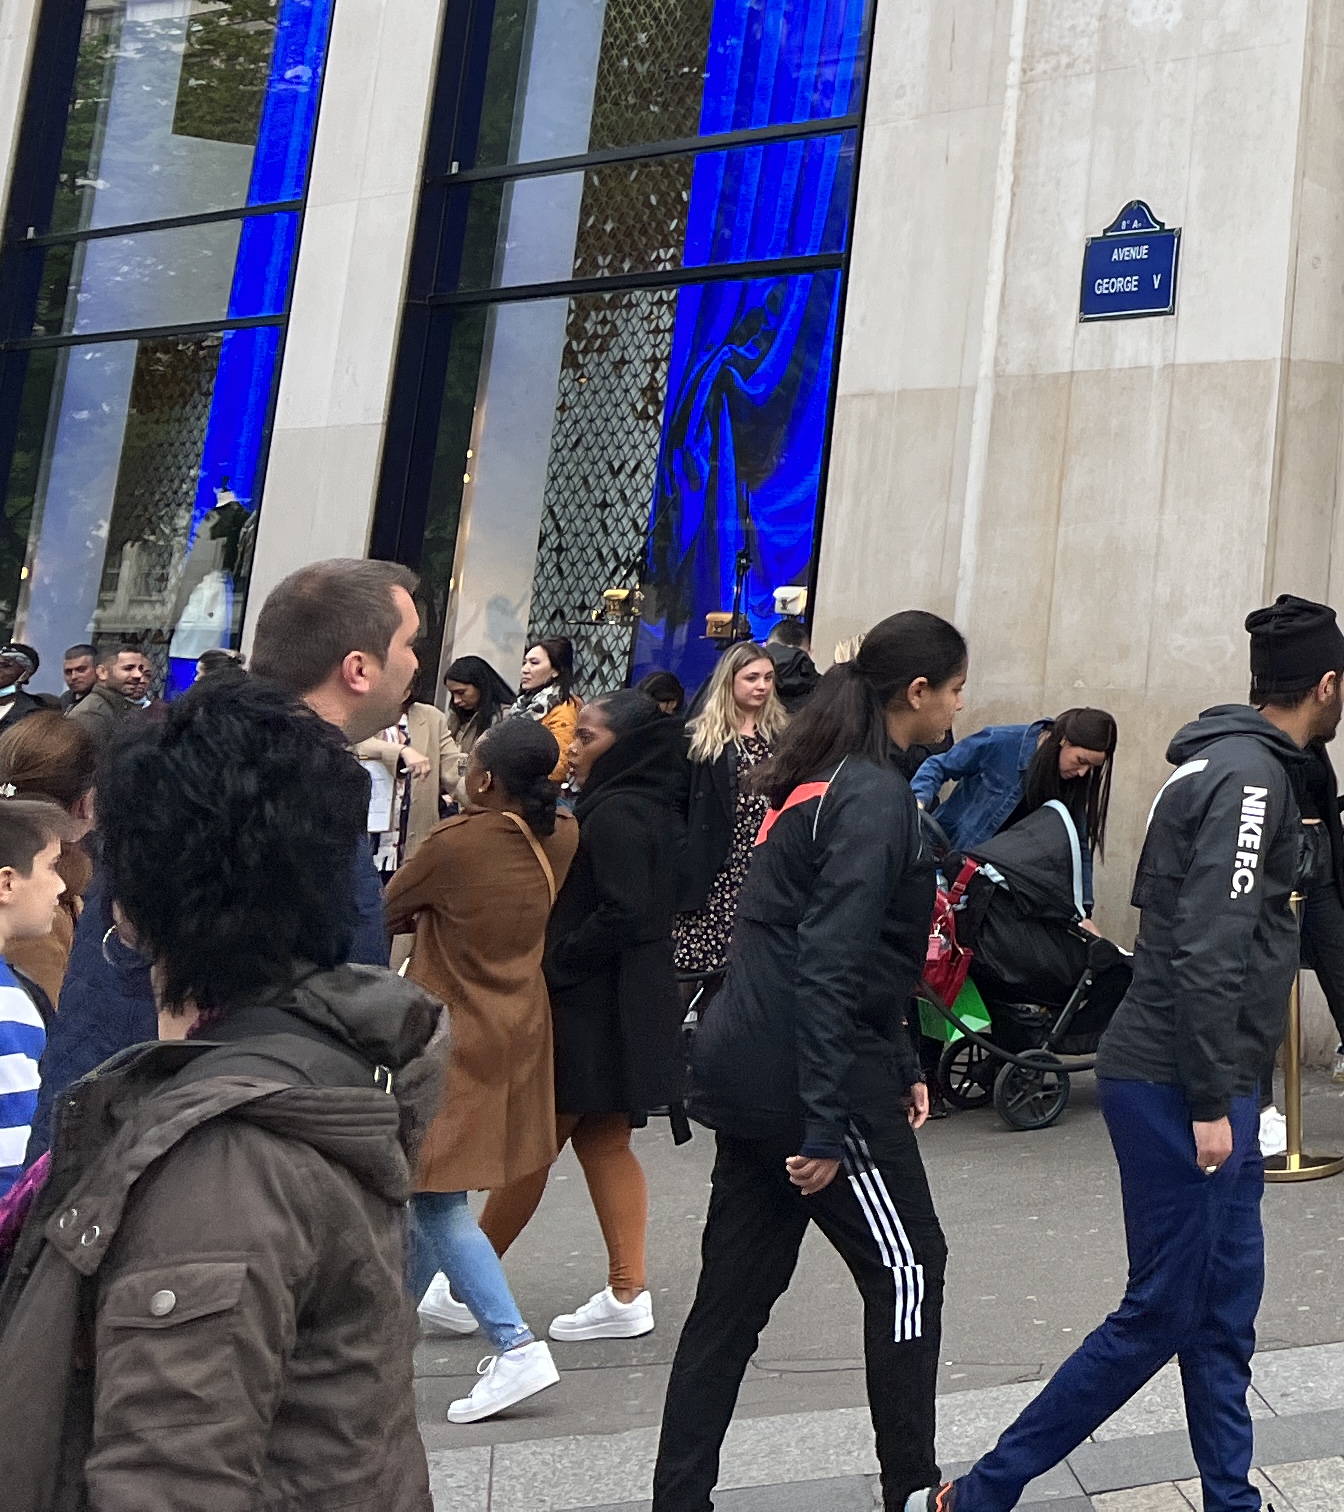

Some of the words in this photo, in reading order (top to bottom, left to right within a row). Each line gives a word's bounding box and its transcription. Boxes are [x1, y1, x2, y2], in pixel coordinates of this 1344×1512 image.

[1112, 245, 1149, 262] AVENUE
[1094, 276, 1139, 294] GEORGE
[1153, 273, 1161, 289] V
[1237, 785, 1268, 850] NIKE
[1230, 850, 1259, 899] F.C.
